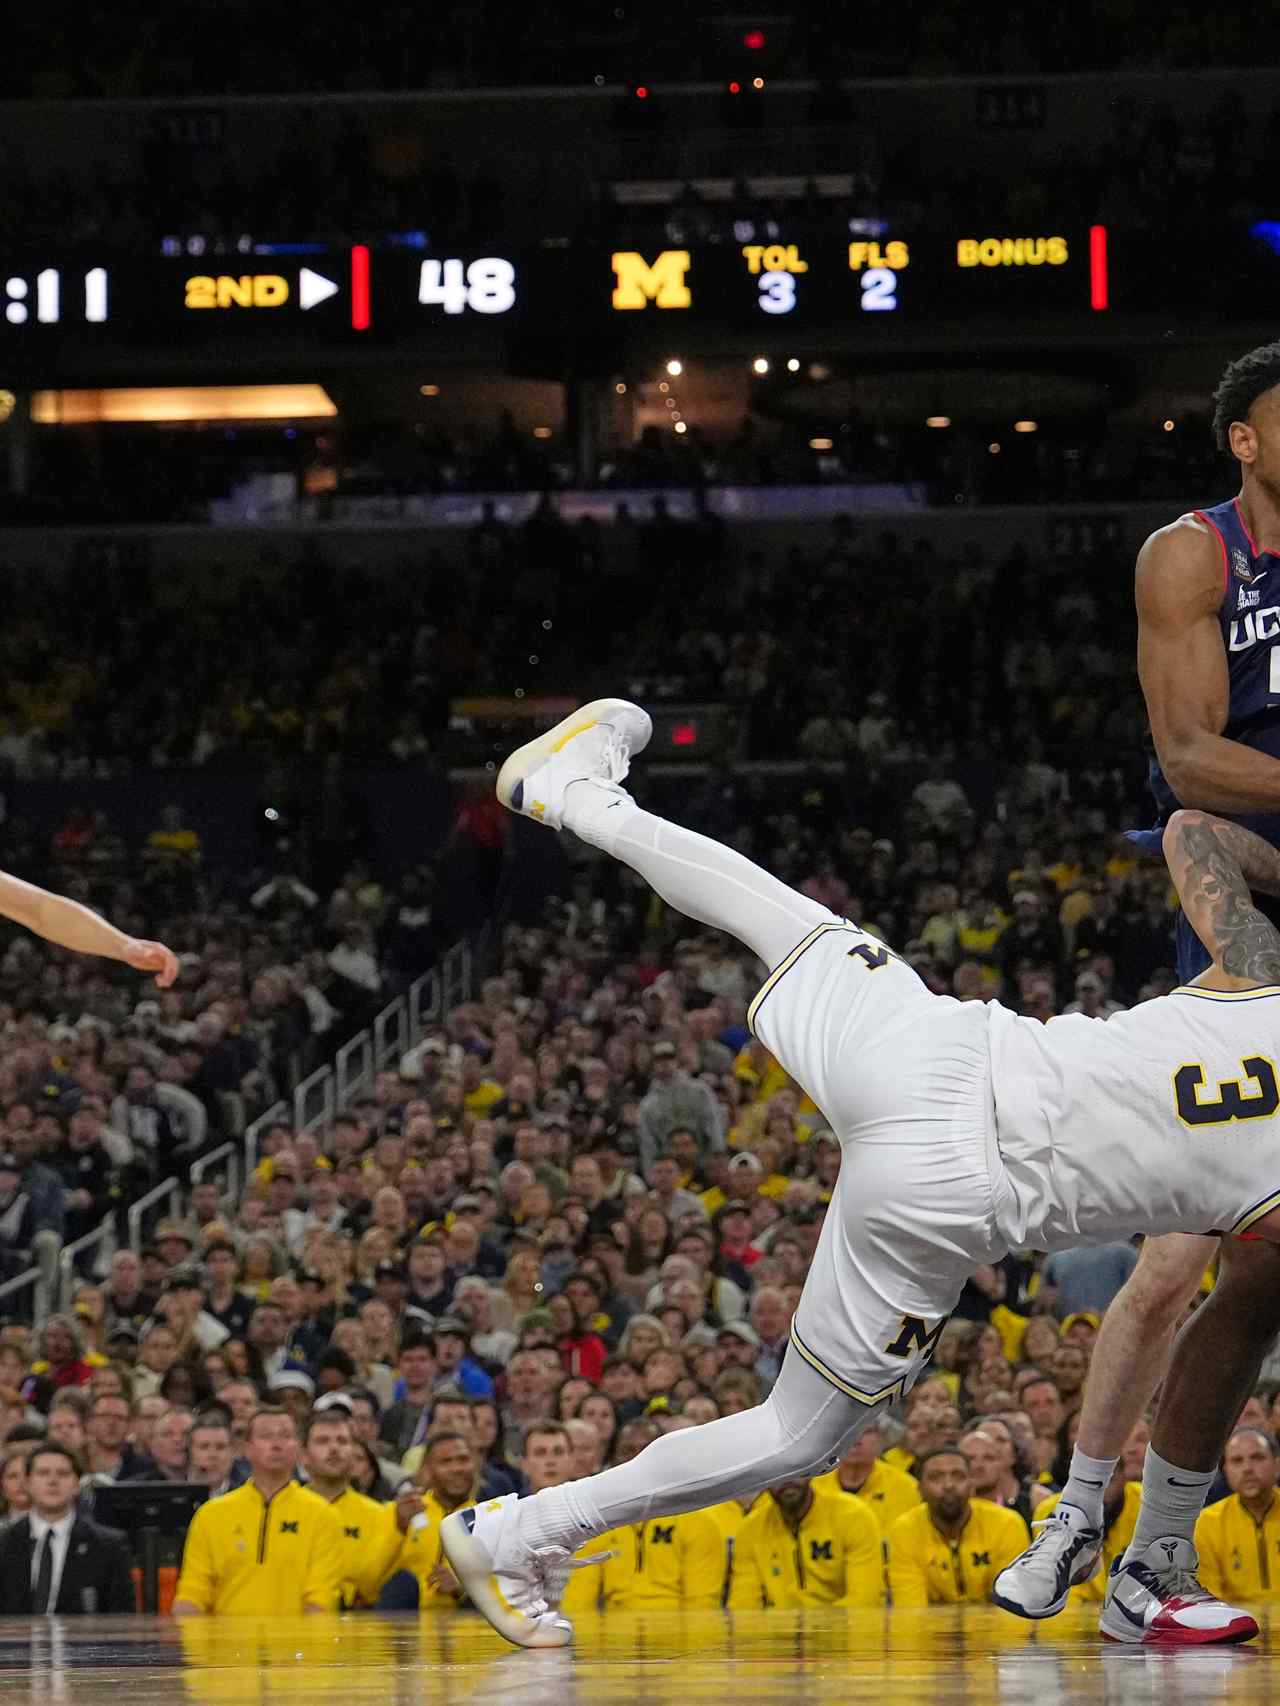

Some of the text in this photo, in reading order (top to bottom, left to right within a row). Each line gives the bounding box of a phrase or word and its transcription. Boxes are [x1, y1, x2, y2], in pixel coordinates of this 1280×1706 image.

[743, 245, 808, 274] TOL
[849, 241, 909, 270] FLS
[957, 237, 1068, 268] BONUS
[185, 275, 289, 308] 2ND
[418, 257, 515, 314] 48
[611, 250, 691, 310] M
[758, 270, 796, 314] 3
[861, 268, 897, 311] 2
[651, 1524, 675, 1543] M
[810, 1539, 833, 1561] M
